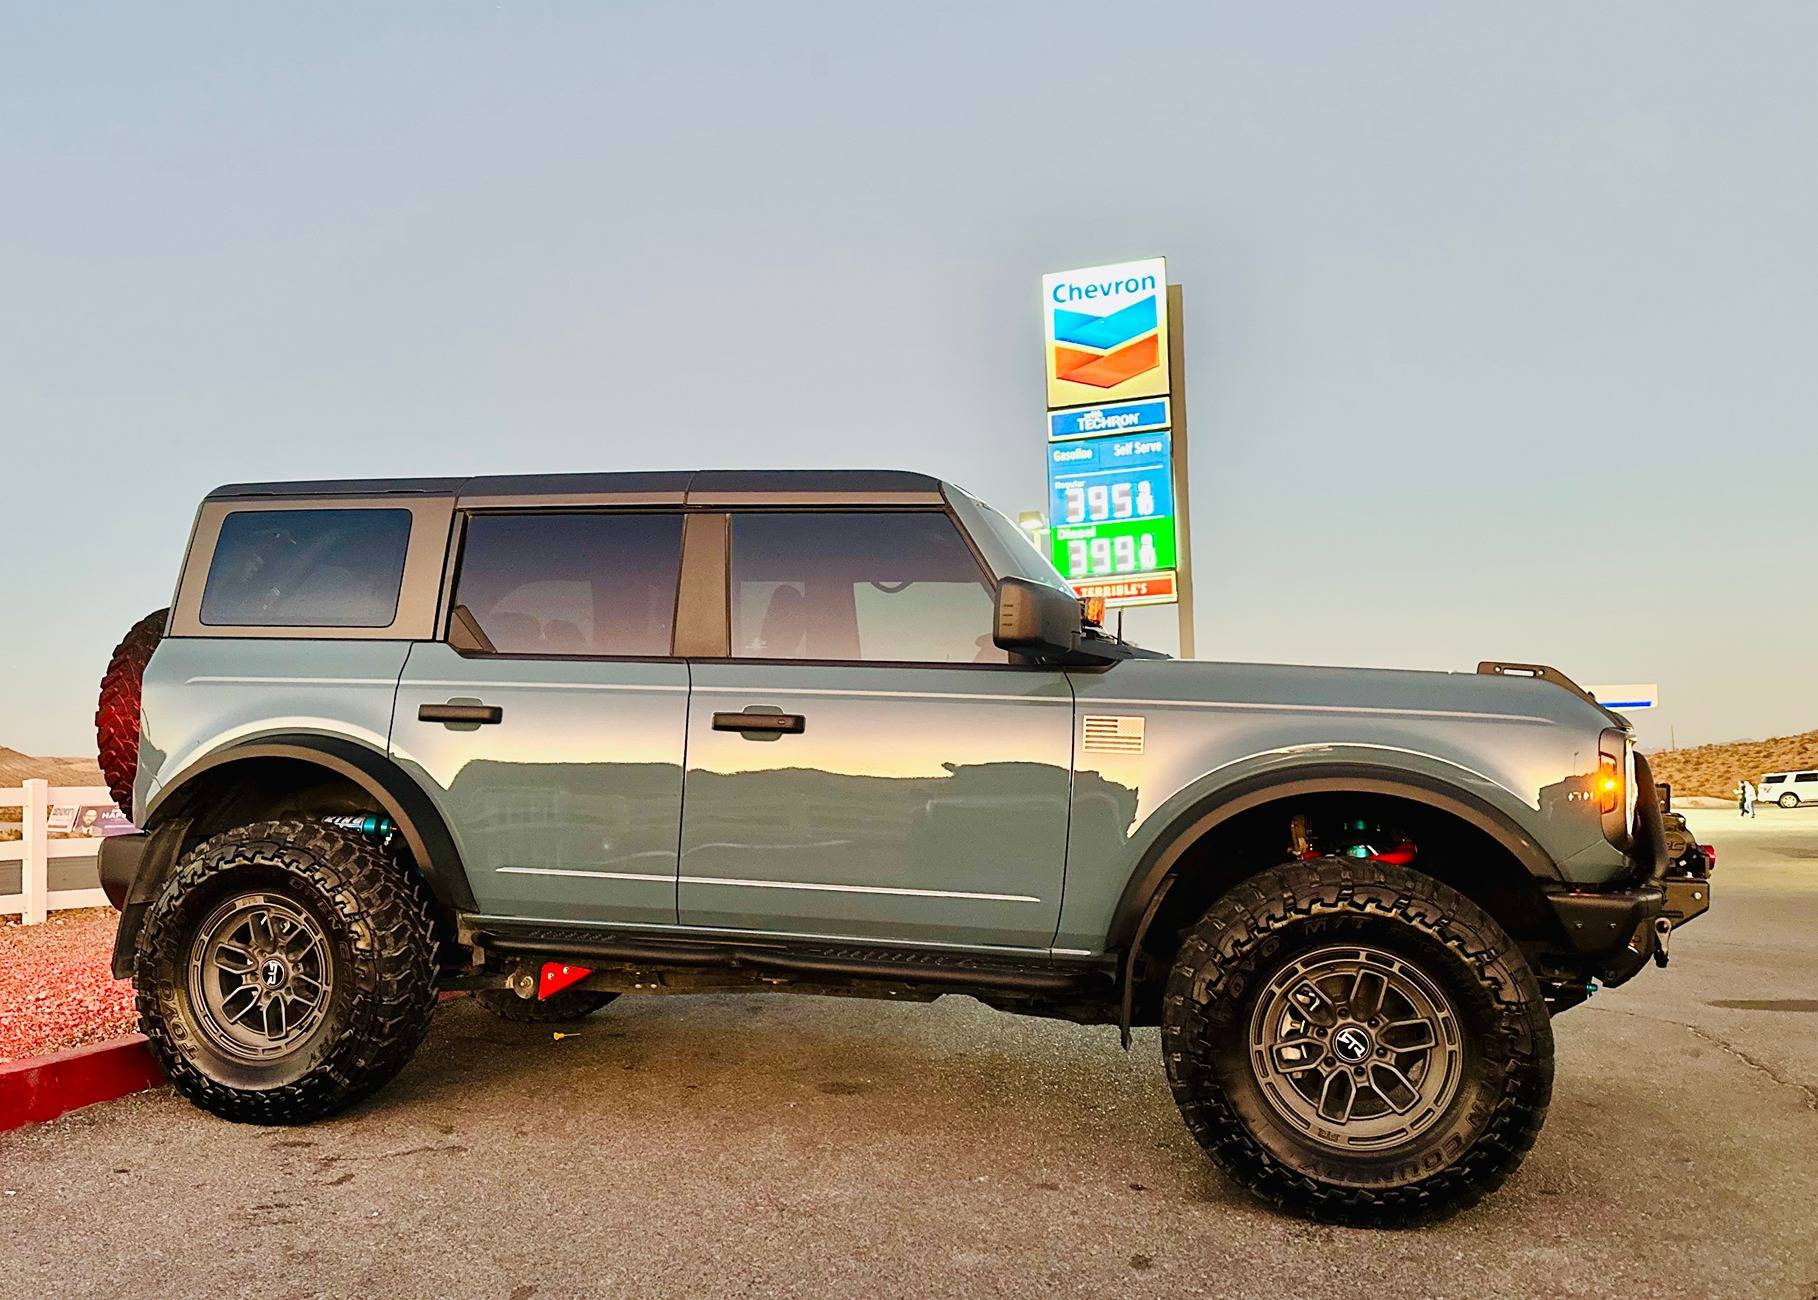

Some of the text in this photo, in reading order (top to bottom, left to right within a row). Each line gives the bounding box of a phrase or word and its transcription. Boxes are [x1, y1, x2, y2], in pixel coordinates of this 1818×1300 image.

[1053, 275, 1155, 303] Chevron
[1077, 413, 1139, 432] TECHRON
[1065, 482, 1132, 523] 395
[1068, 535, 1134, 577] 399
[1080, 582, 1148, 598] TERRIBLE'S
